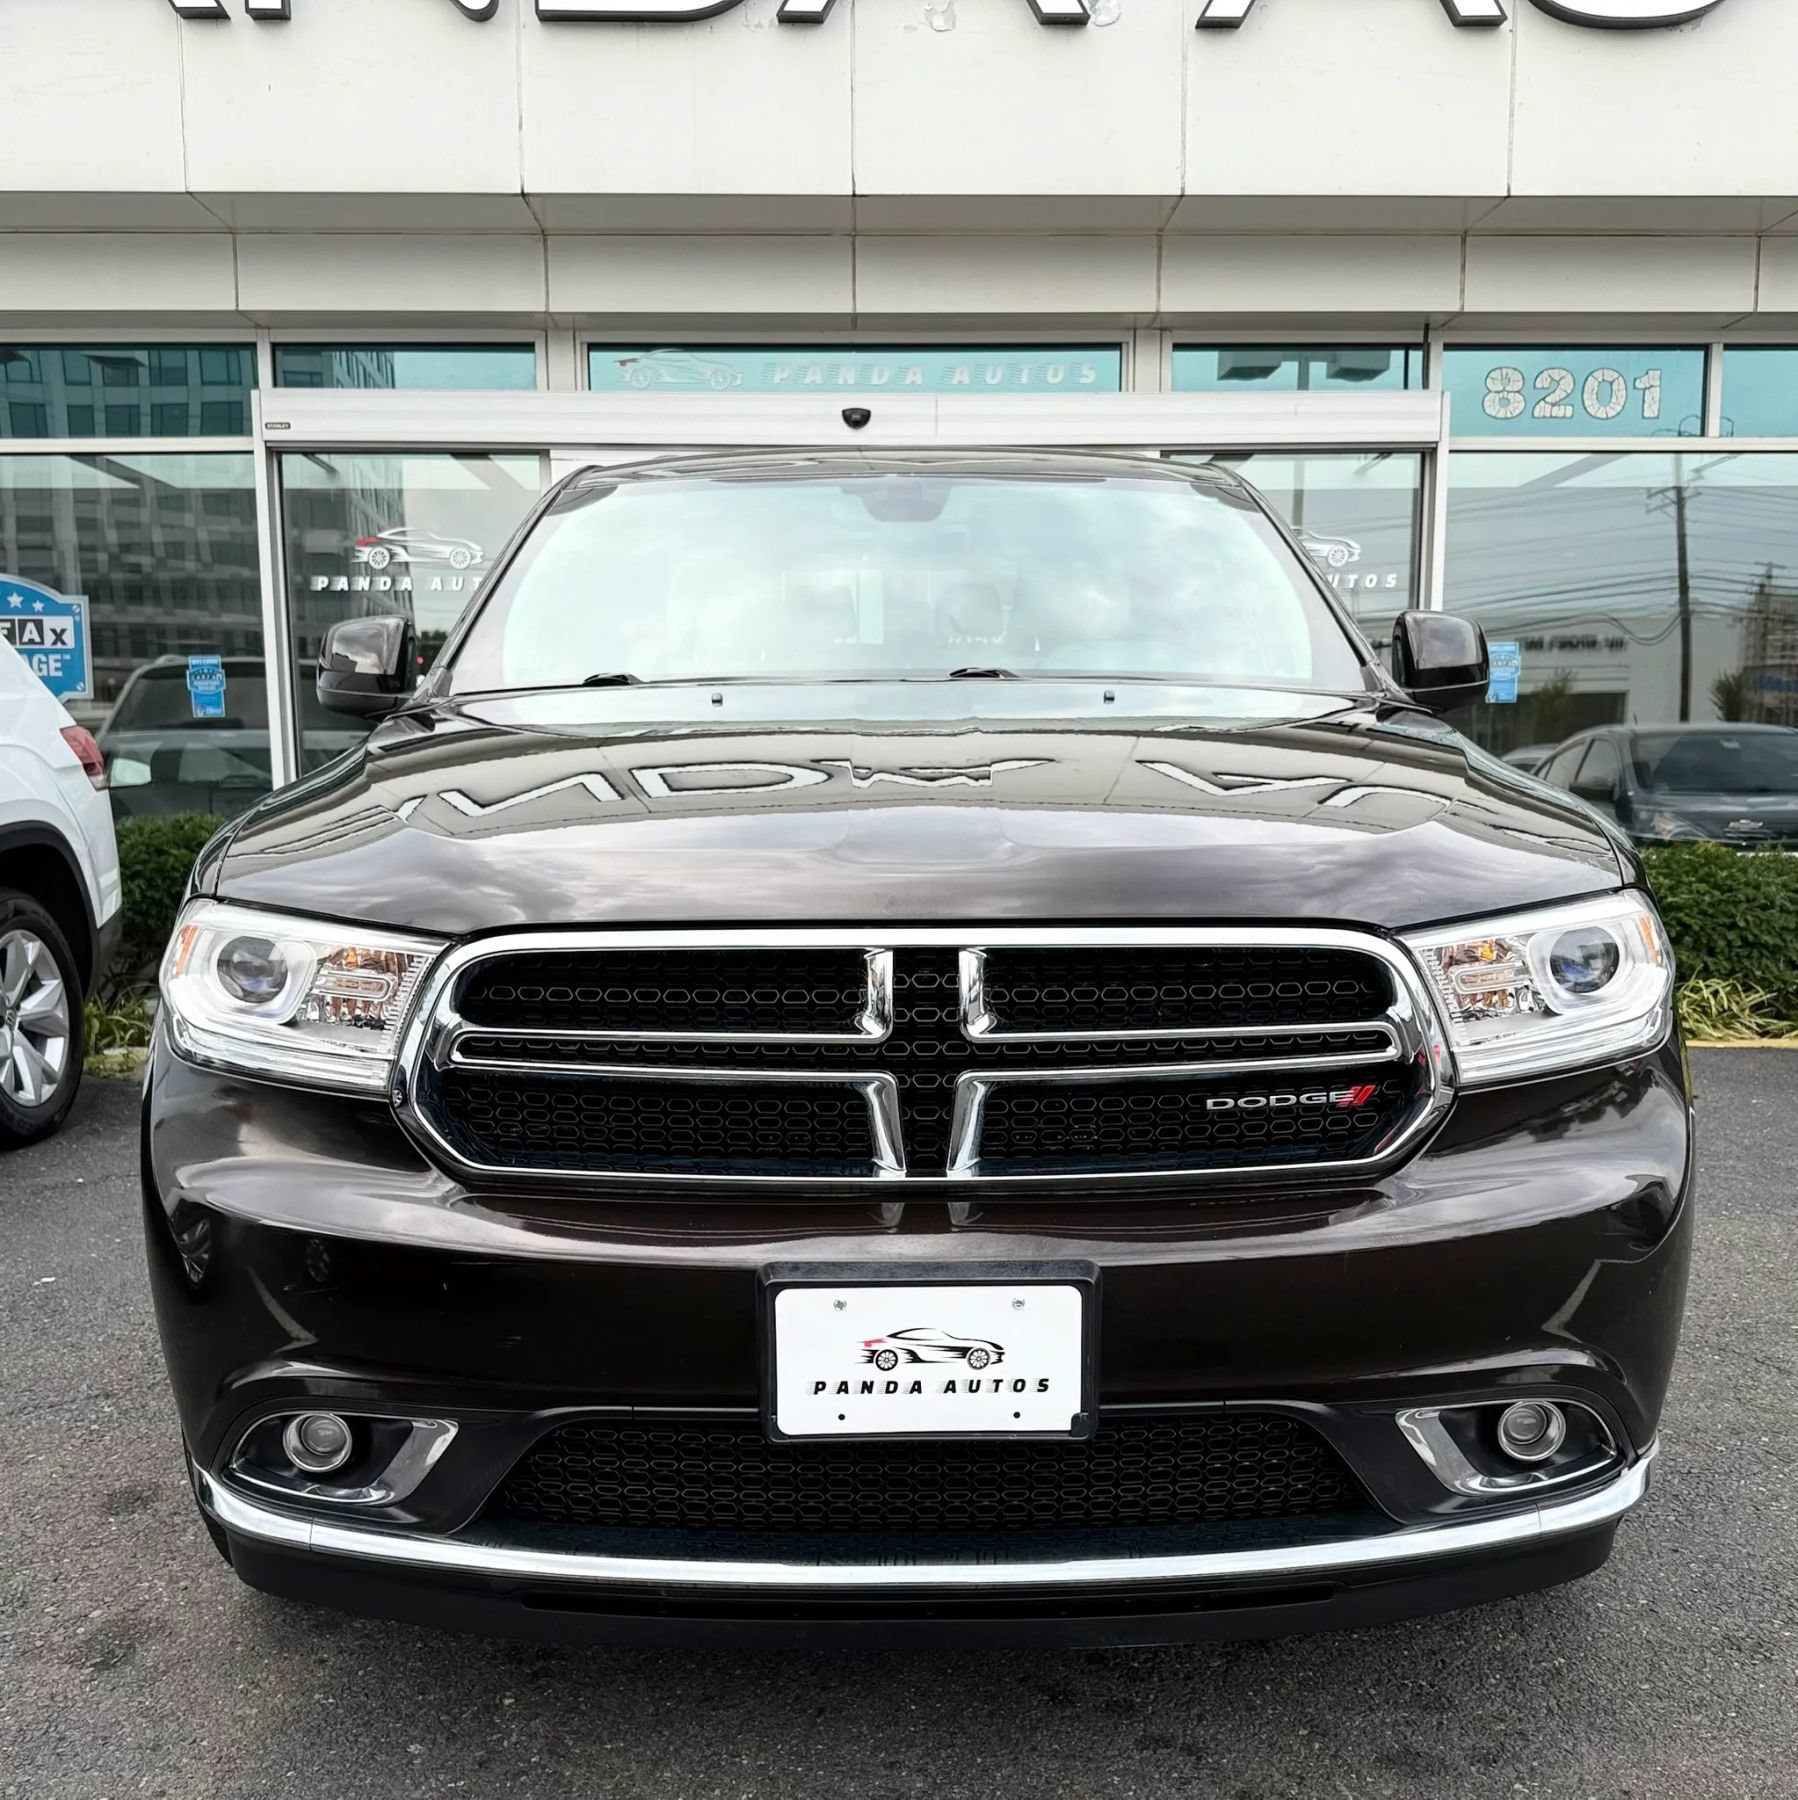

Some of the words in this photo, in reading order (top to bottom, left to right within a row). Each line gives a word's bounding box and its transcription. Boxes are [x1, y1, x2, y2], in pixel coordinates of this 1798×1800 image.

[764, 362, 923, 385] PANDA
[945, 362, 1097, 385] AUTOS
[1482, 366, 1662, 419] 8201
[312, 576, 414, 592] PANDA
[1206, 1090, 1355, 1110] DODGE
[810, 1380, 923, 1396] PANDA
[940, 1378, 1050, 1395] AUTOS
